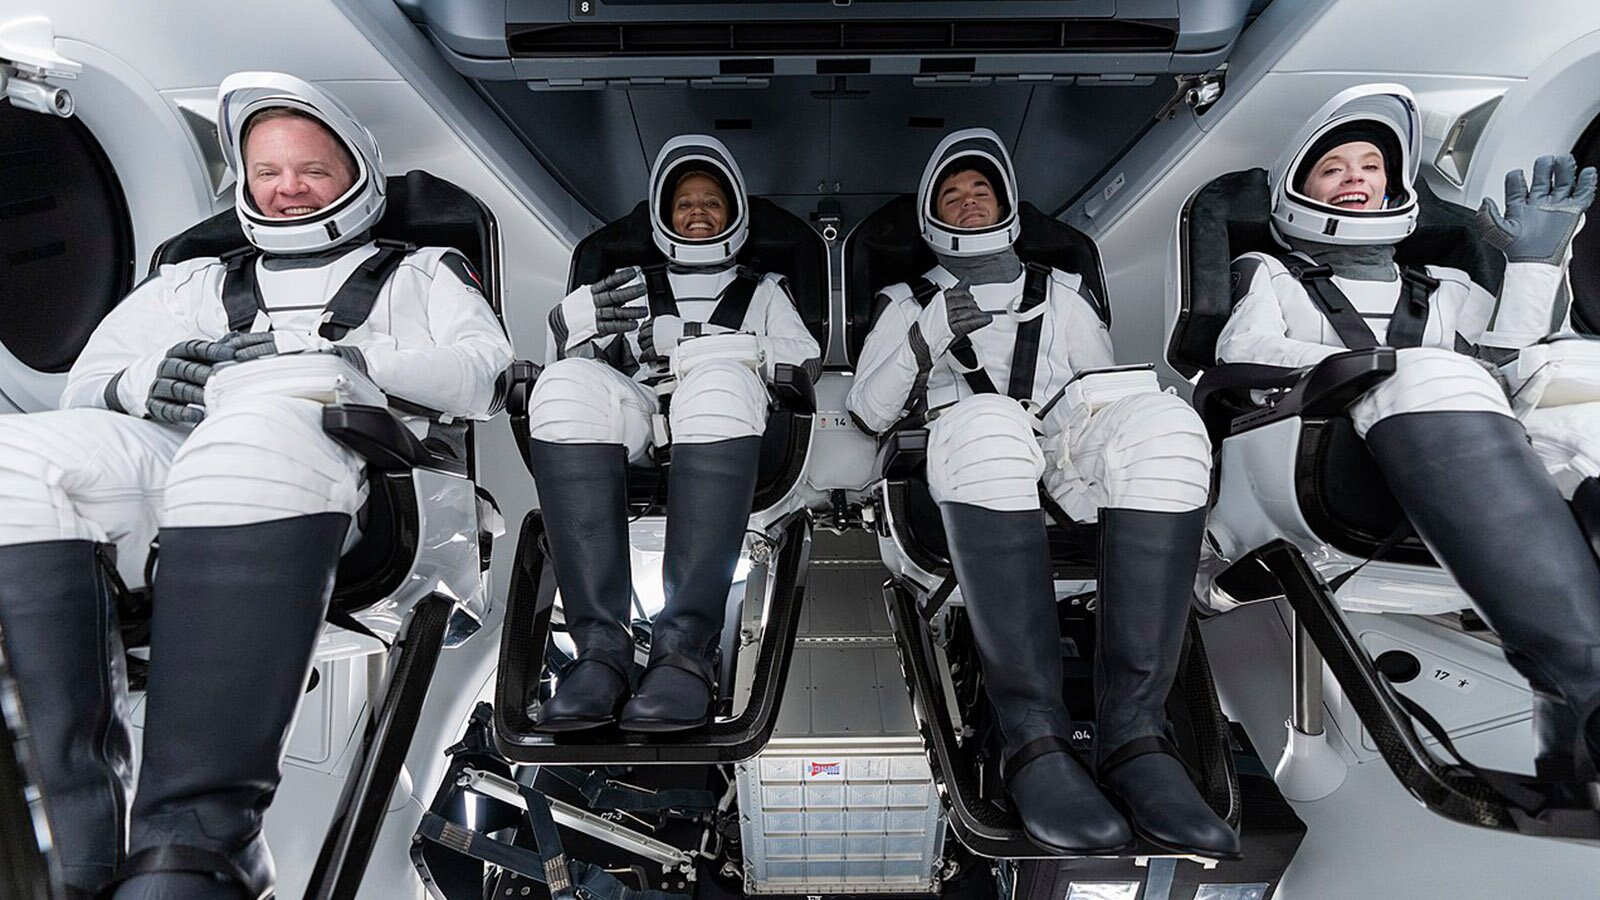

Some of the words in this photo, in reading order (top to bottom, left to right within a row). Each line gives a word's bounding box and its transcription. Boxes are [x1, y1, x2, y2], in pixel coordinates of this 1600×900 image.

[581, 1, 589, 12] 8
[834, 418, 846, 426] 14
[1434, 669, 1450, 680] 17
